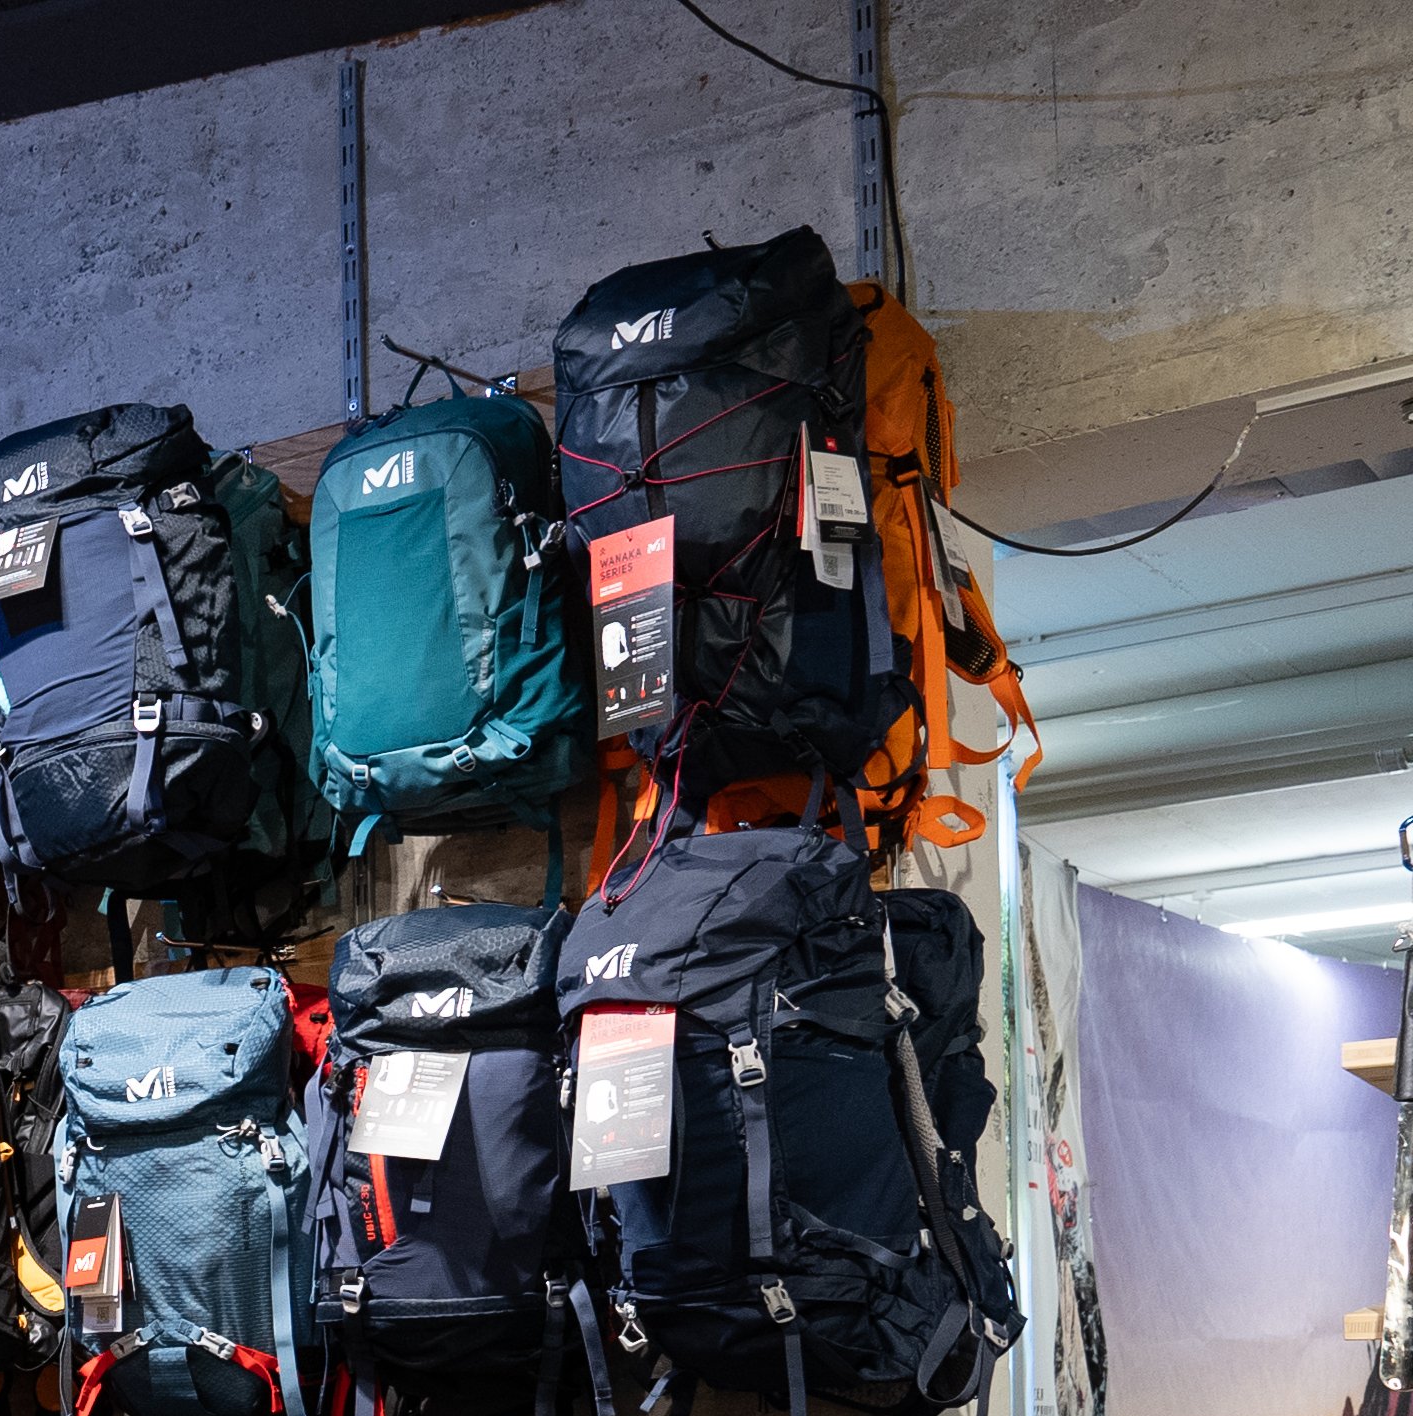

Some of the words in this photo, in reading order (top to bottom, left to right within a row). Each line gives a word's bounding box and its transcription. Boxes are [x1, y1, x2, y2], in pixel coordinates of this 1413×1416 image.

[663, 308, 676, 339] MILLET
[40, 461, 49, 491] MILLET
[404, 450, 415, 484] MILLET
[599, 548, 642, 568] WANAKA
[599, 563, 633, 581] SERIES
